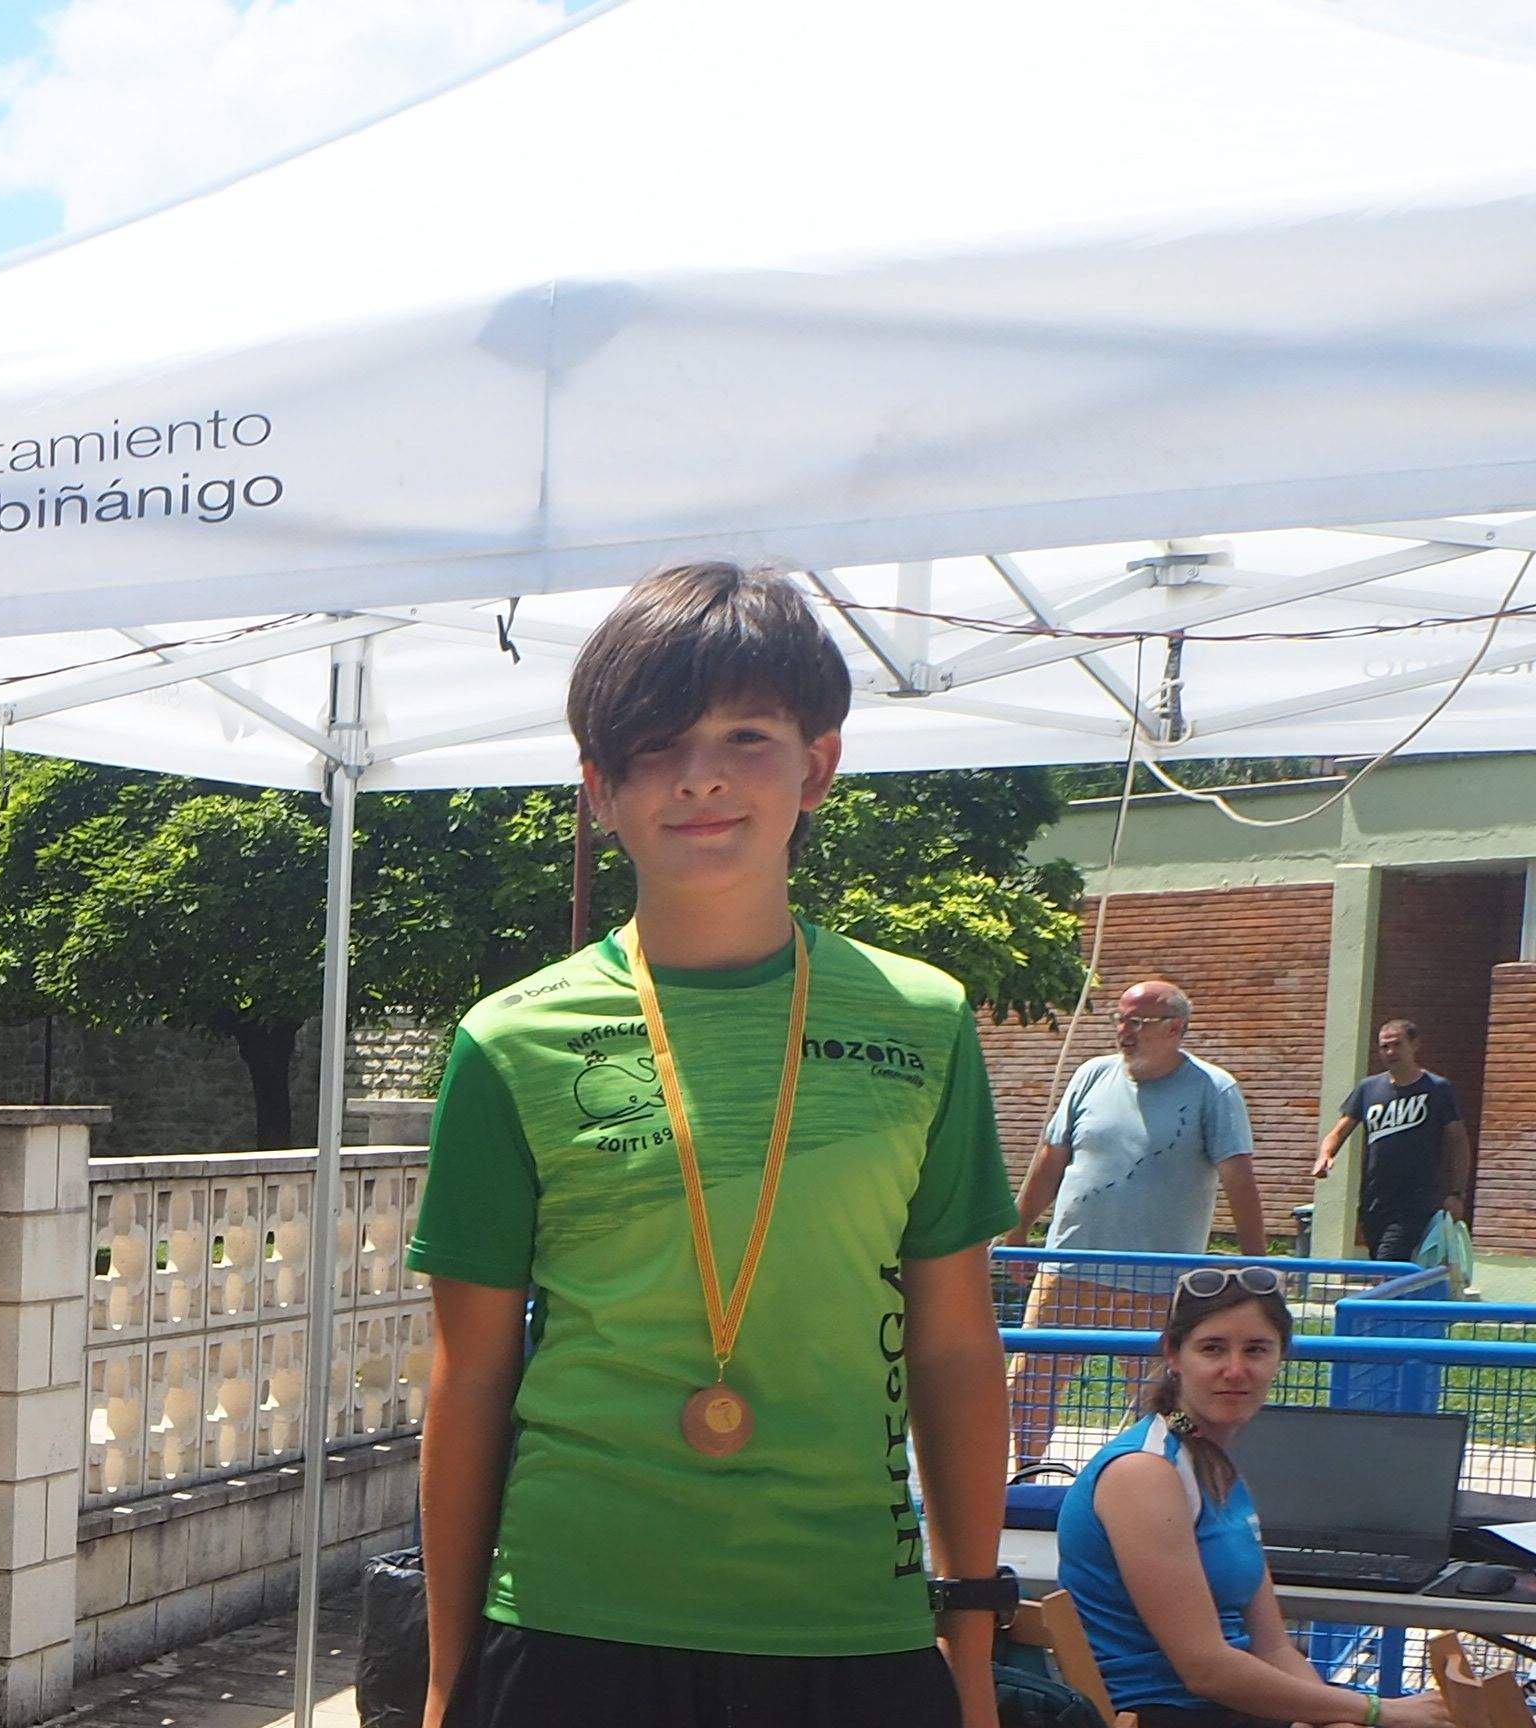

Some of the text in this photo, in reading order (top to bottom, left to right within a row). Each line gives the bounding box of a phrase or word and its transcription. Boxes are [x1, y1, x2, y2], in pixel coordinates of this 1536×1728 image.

[566, 1021, 649, 1053] NATACIO
[1367, 1093, 1428, 1133] RAW
[596, 1126, 674, 1153] ZOITI 89
